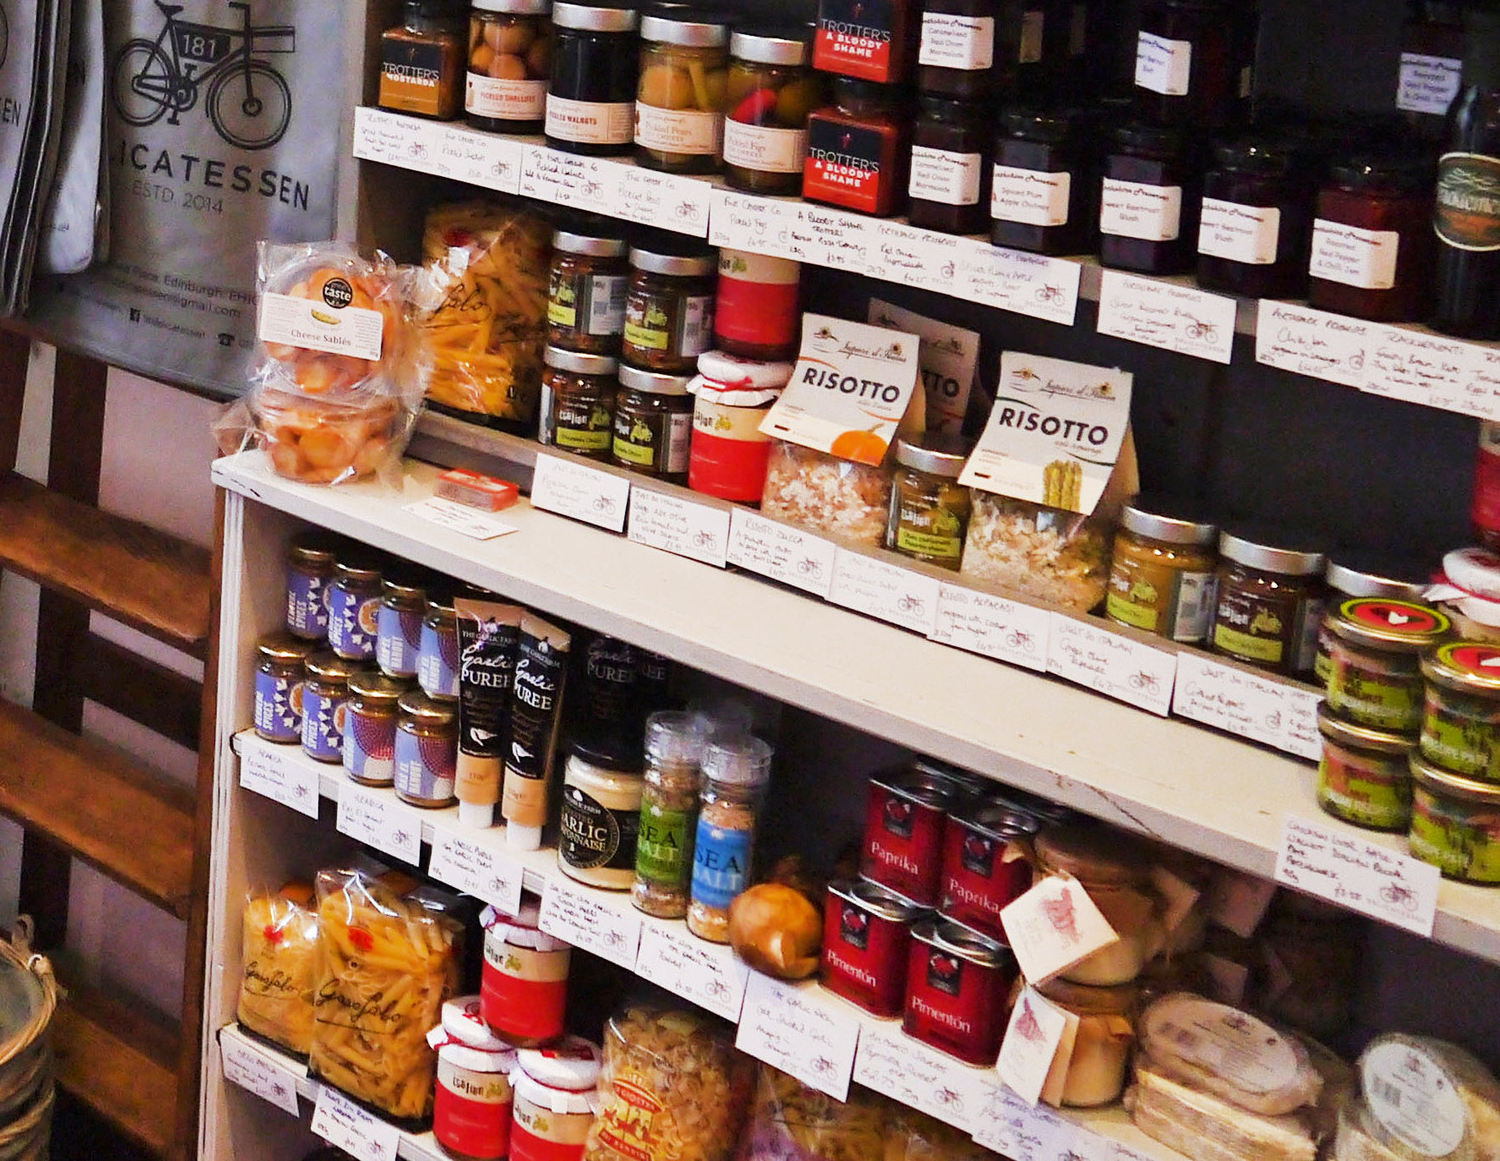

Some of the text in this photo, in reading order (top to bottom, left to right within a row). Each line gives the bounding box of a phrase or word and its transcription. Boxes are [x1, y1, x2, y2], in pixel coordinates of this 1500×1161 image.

[821, 18, 891, 43] TROTTER'S
[826, 31, 882, 49] A BLOODY
[182, 34, 218, 59] 181
[833, 43, 872, 58] SHAME
[383, 61, 440, 81] TROTTER'S
[810, 147, 880, 174] TROTTER'S
[815, 161, 872, 181] A BLOODY
[822, 171, 861, 188] SHAME
[183, 193, 223, 215] 2014
[324, 284, 352, 301] taste
[291, 328, 320, 343] Cheese
[802, 367, 900, 403] RISOTTO
[999, 407, 1109, 446] RISOTTO
[694, 844, 741, 875] SEA
[870, 840, 920, 877] Paprika
[948, 878, 1001, 915] Paprika
[827, 948, 877, 990] Pimentón
[911, 995, 972, 1035] Pimentón
